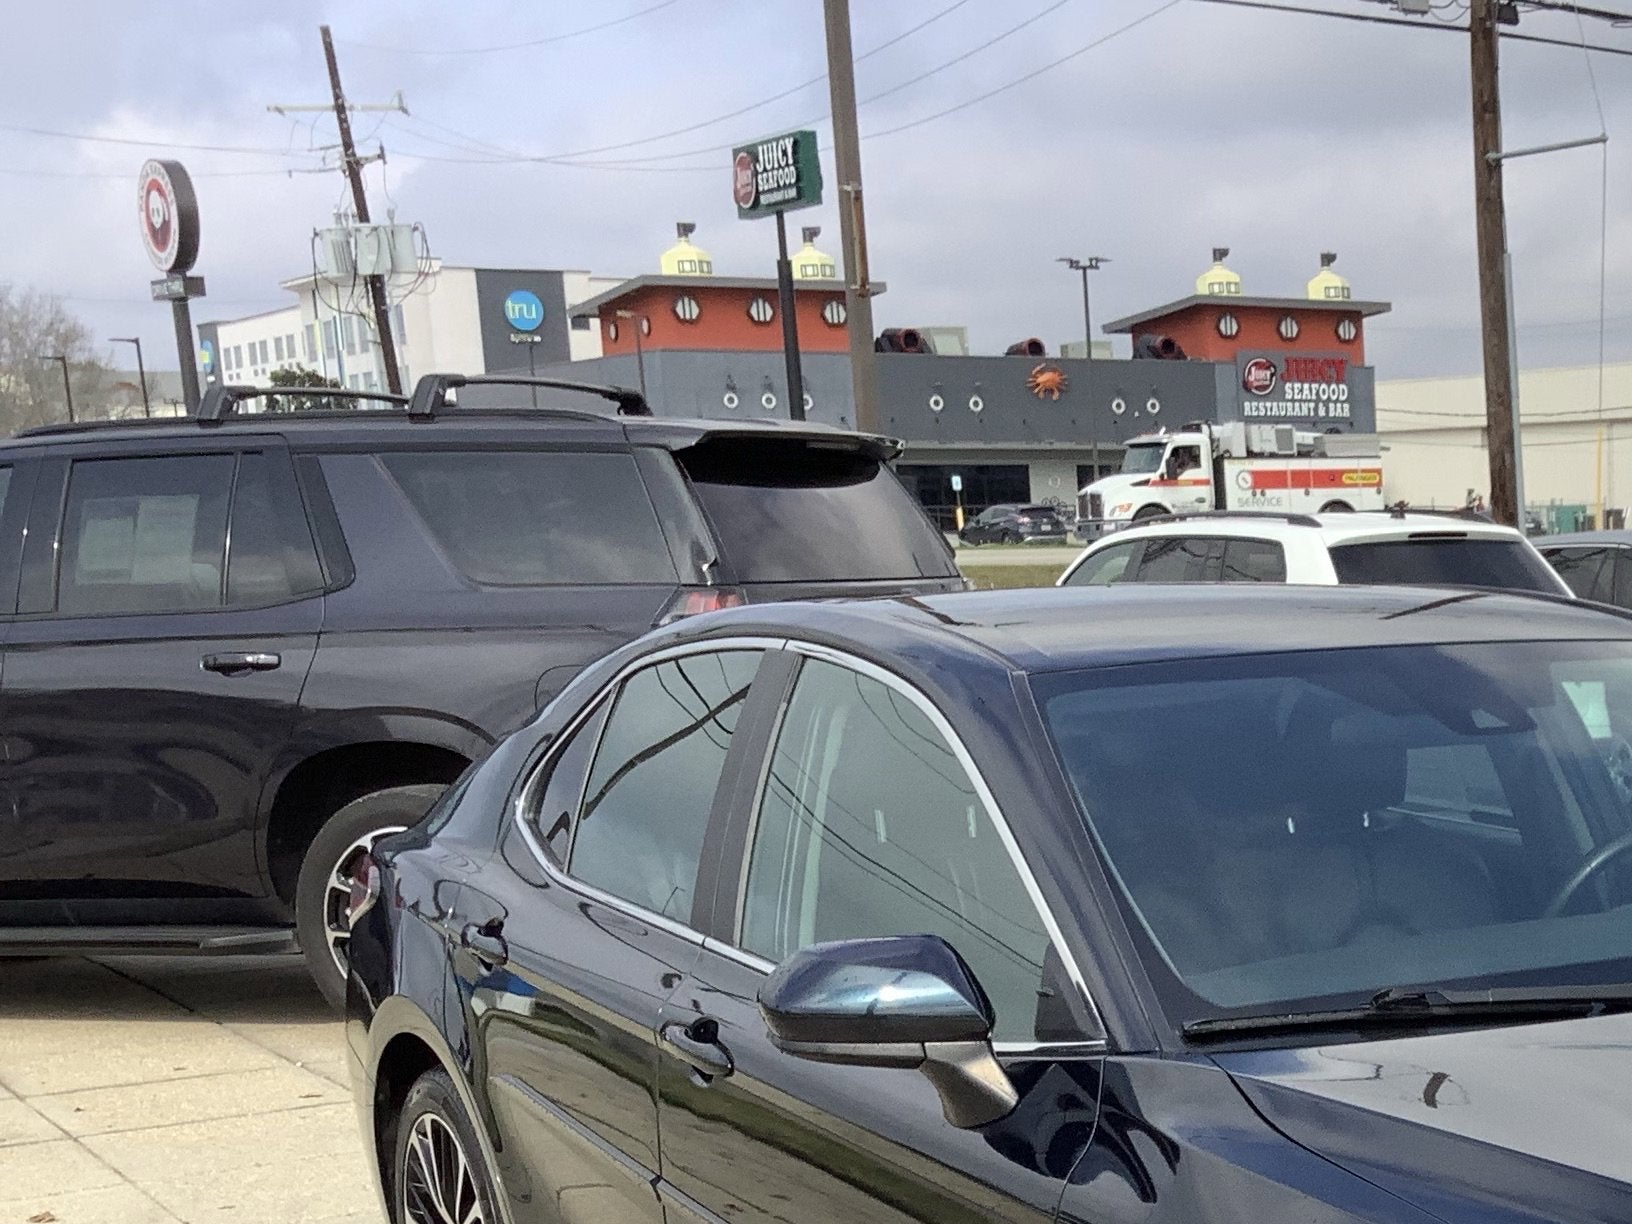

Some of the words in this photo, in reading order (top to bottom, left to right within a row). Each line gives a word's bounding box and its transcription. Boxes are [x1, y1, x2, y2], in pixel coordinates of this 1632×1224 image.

[756, 137, 794, 172] JUICY
[757, 165, 797, 192] SEAFOOD
[508, 300, 536, 319] tru
[1284, 382, 1349, 401] SEAFOOD
[1243, 401, 1315, 417] RESTAURANT
[1318, 402, 1326, 417] &
[1328, 403, 1350, 418] BAR
